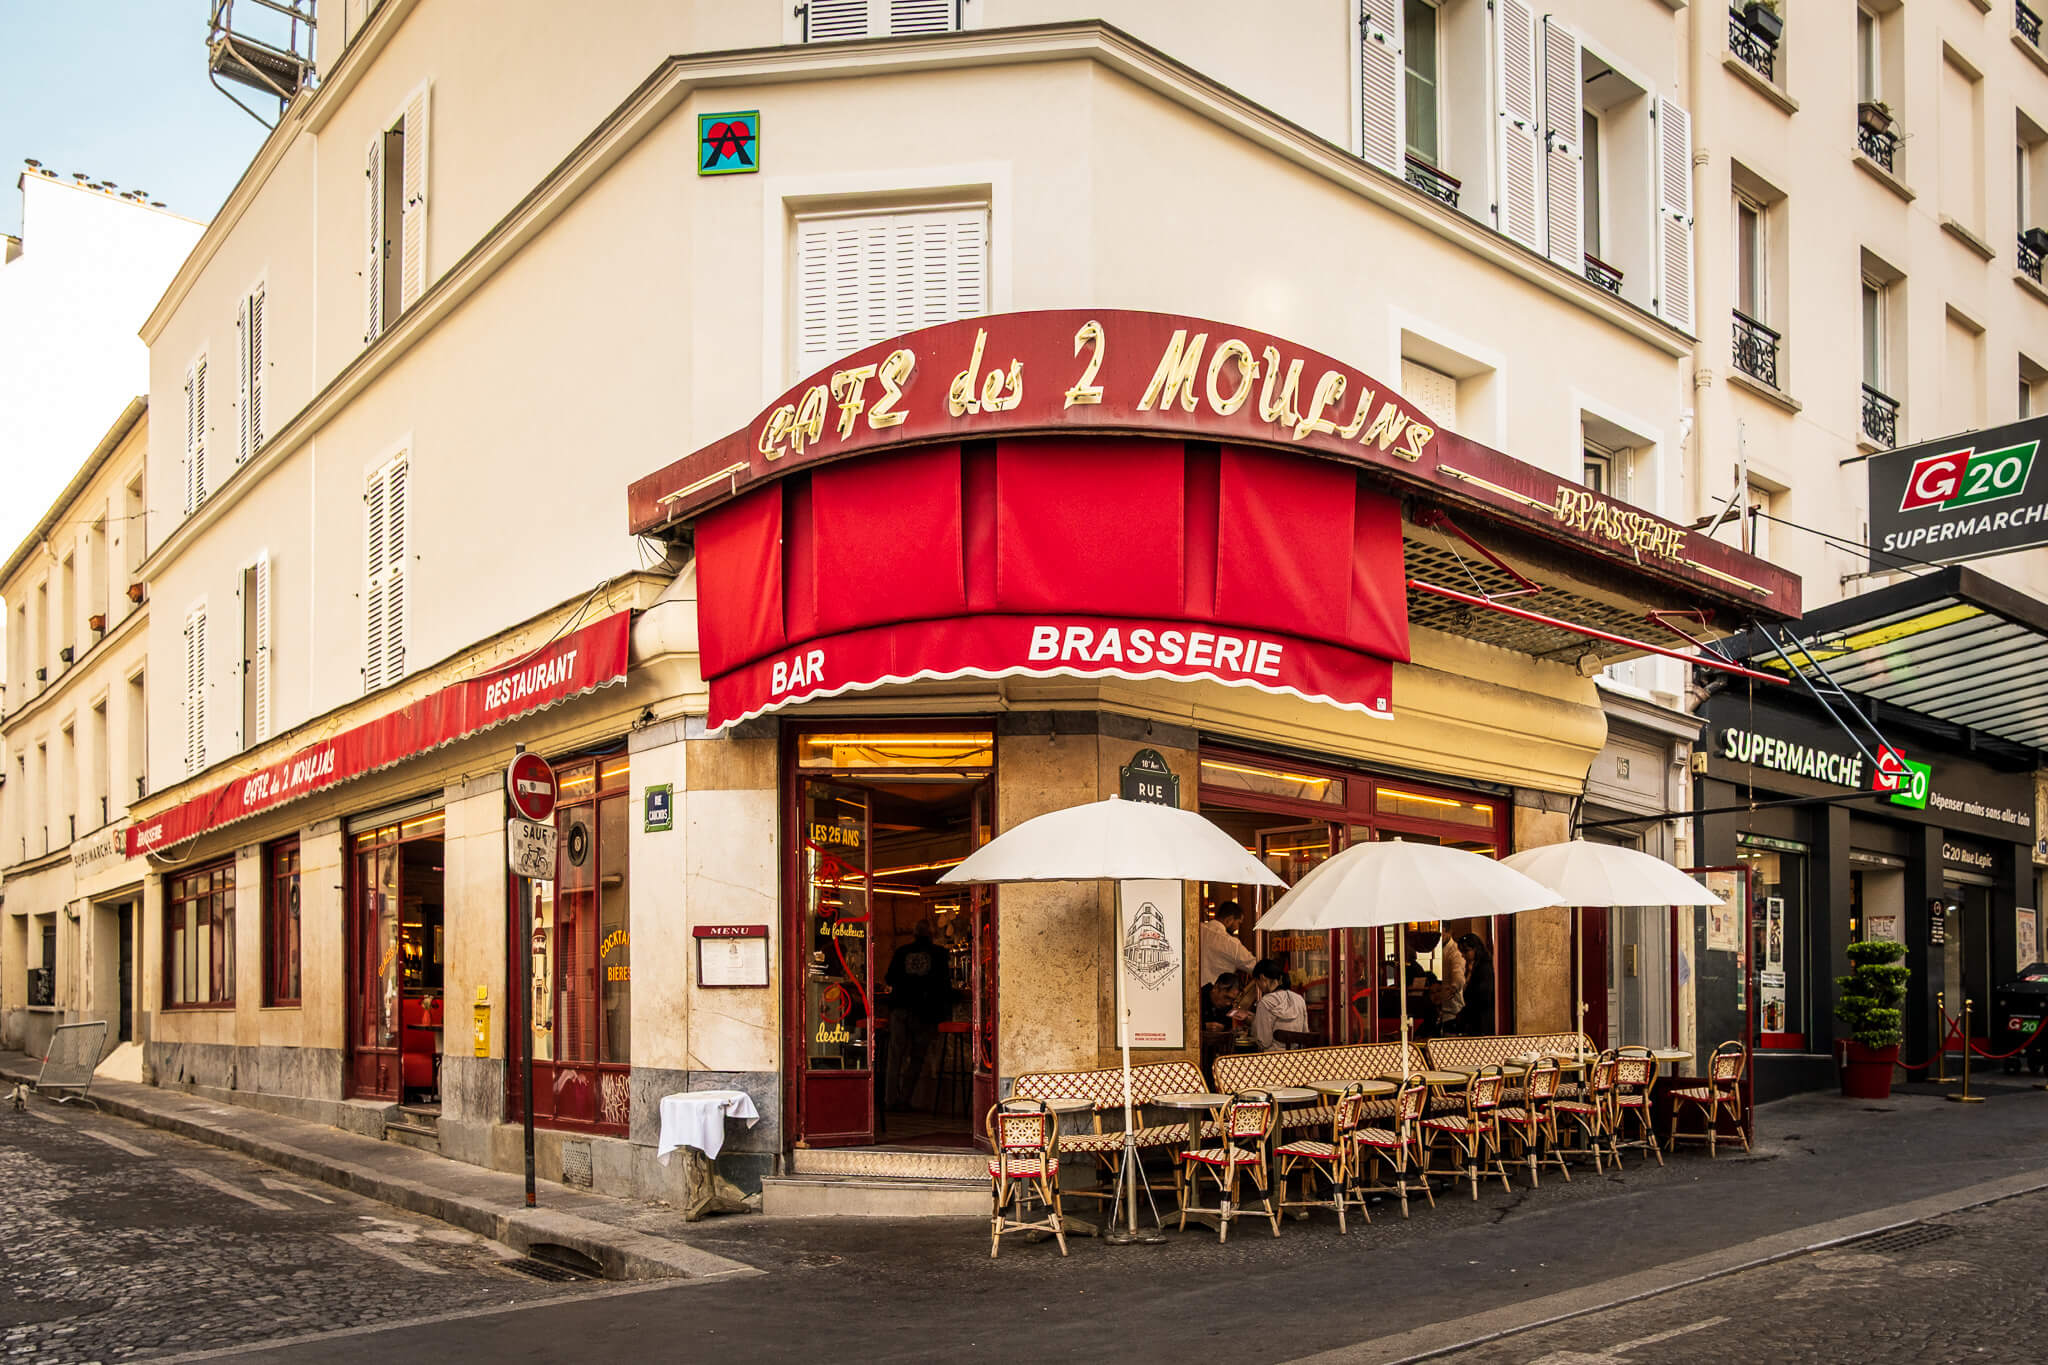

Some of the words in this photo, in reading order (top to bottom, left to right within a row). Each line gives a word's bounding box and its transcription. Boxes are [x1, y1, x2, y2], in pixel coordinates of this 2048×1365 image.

[948, 328, 1024, 418] des
[1064, 320, 1106, 410] 2
[1137, 329, 1435, 462] MOULINS
[1915, 456, 2022, 499] G20
[1028, 625, 1285, 678] BRASSERIE
[484, 650, 578, 711] RESTAURANT
[770, 649, 827, 697] BAR
[1725, 727, 1863, 789] SUPERMARCHÉ
[281, 764, 290, 792] 2
[1138, 782, 1163, 799] RUE
[1930, 792, 1964, 811] Dépenser
[1964, 801, 1985, 817] moins
[1985, 806, 2001, 820] sans
[2001, 808, 2017, 824] aller
[2017, 811, 2030, 827] loin
[523, 825, 548, 842] SAUF
[810, 822, 828, 842] LES
[828, 826, 841, 843] 25
[842, 828, 860, 847] ANS
[1942, 843, 1961, 860] G20
[1961, 849, 1975, 864] Rue
[1975, 852, 1993, 868] Lepic
[710, 927, 750, 936] MENU
[820, 922, 831, 936] du
[831, 922, 865, 940] fabuleux
[815, 1022, 850, 1045] destin
